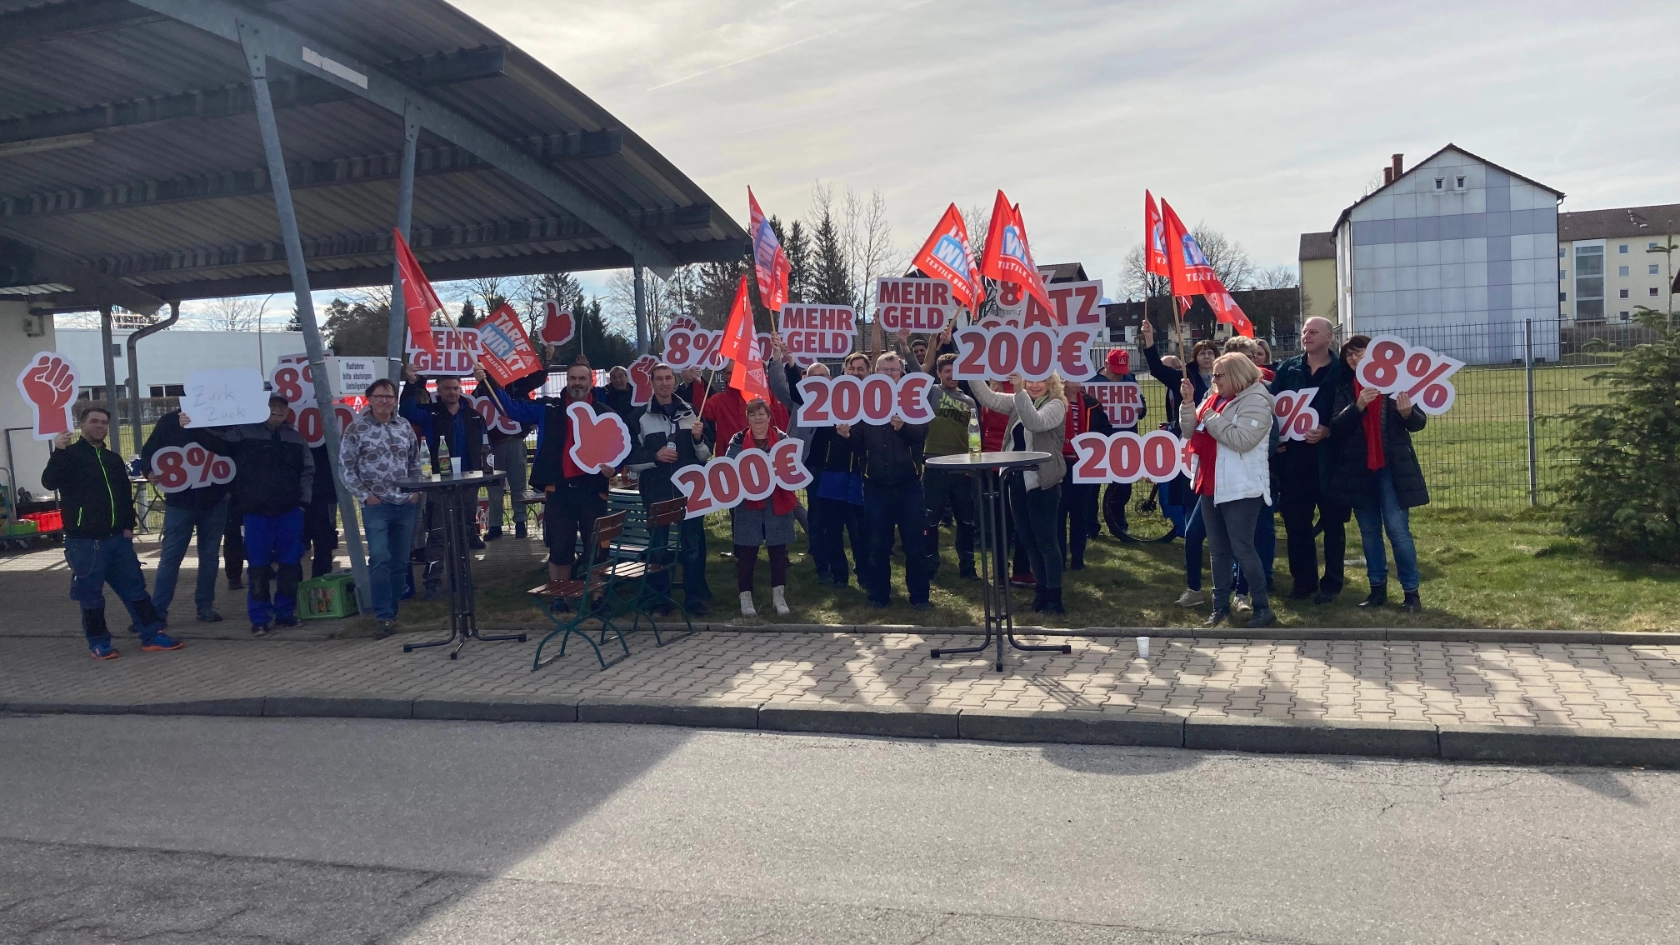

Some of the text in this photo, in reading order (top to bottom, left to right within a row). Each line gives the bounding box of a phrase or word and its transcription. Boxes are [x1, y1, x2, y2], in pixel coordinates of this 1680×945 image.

[925, 256, 954, 280] TEXTILE
[880, 282, 949, 305] MEHR
[493, 312, 532, 356] TARIF
[783, 307, 853, 331] MEHR
[883, 306, 944, 330] GELD
[480, 326, 526, 372] WIRKT
[667, 332, 725, 366] 8%
[786, 331, 849, 353] GELD
[959, 331, 1090, 376] 200€
[414, 351, 474, 371] GELD
[1363, 341, 1452, 409] 8%
[203, 404, 246, 422] Zuck
[802, 378, 929, 421] 200€
[156, 447, 231, 488] 8%
[678, 444, 806, 513] 200€
